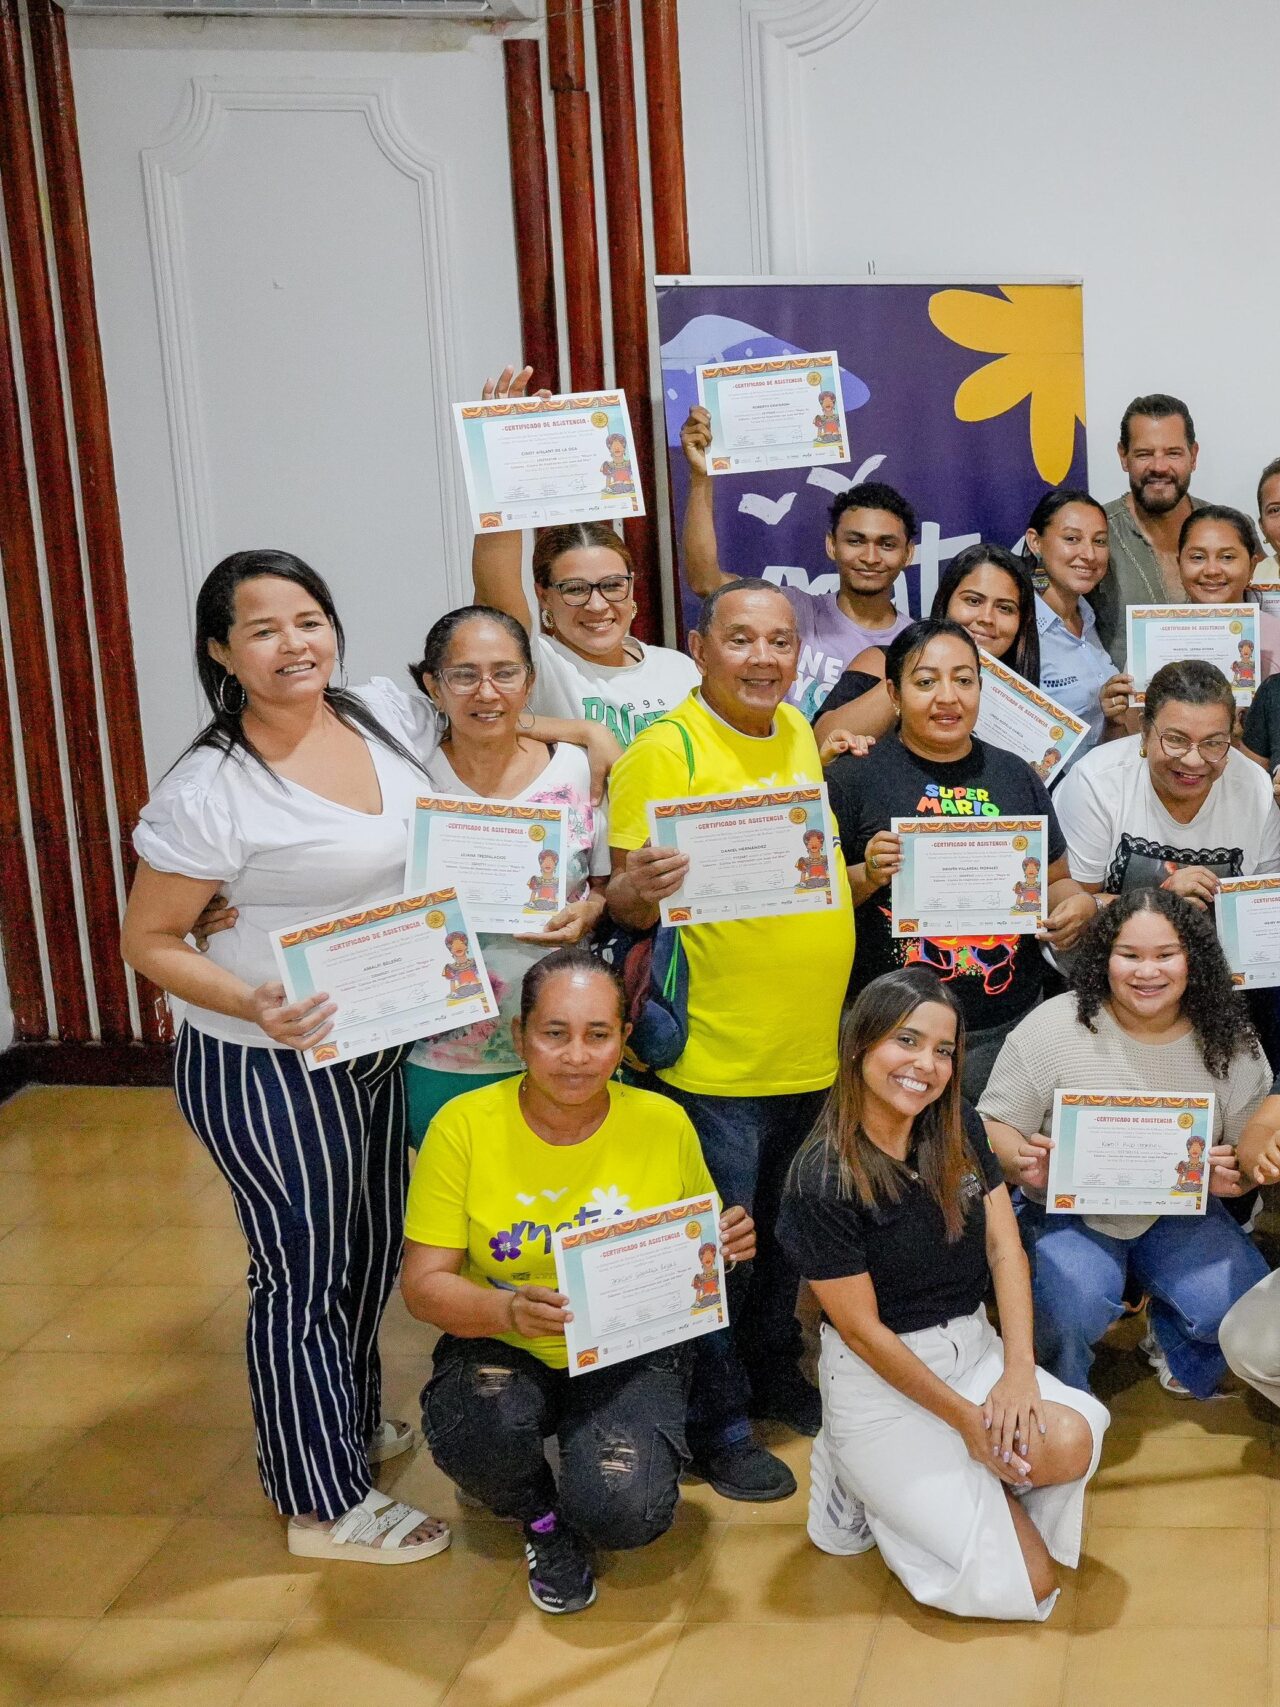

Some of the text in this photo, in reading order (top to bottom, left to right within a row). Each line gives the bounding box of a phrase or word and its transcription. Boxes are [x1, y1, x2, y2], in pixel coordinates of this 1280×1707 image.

[505, 421, 541, 431] CERTIFICADO
[797, 644, 843, 685] NE
[925, 783, 990, 802] SUPER
[916, 796, 1000, 817] MARIO
[448, 823, 481, 831] CERTIFICADO
[698, 820, 736, 829] CERTIFICADO
[749, 815, 783, 824] ASISTENCIA
[329, 935, 371, 952] CERTIFICADO
[382, 921, 421, 937] ASISTENCIA
[603, 1243, 638, 1258] CERTIFICADO
[648, 1232, 681, 1246] ASISTENCIA
